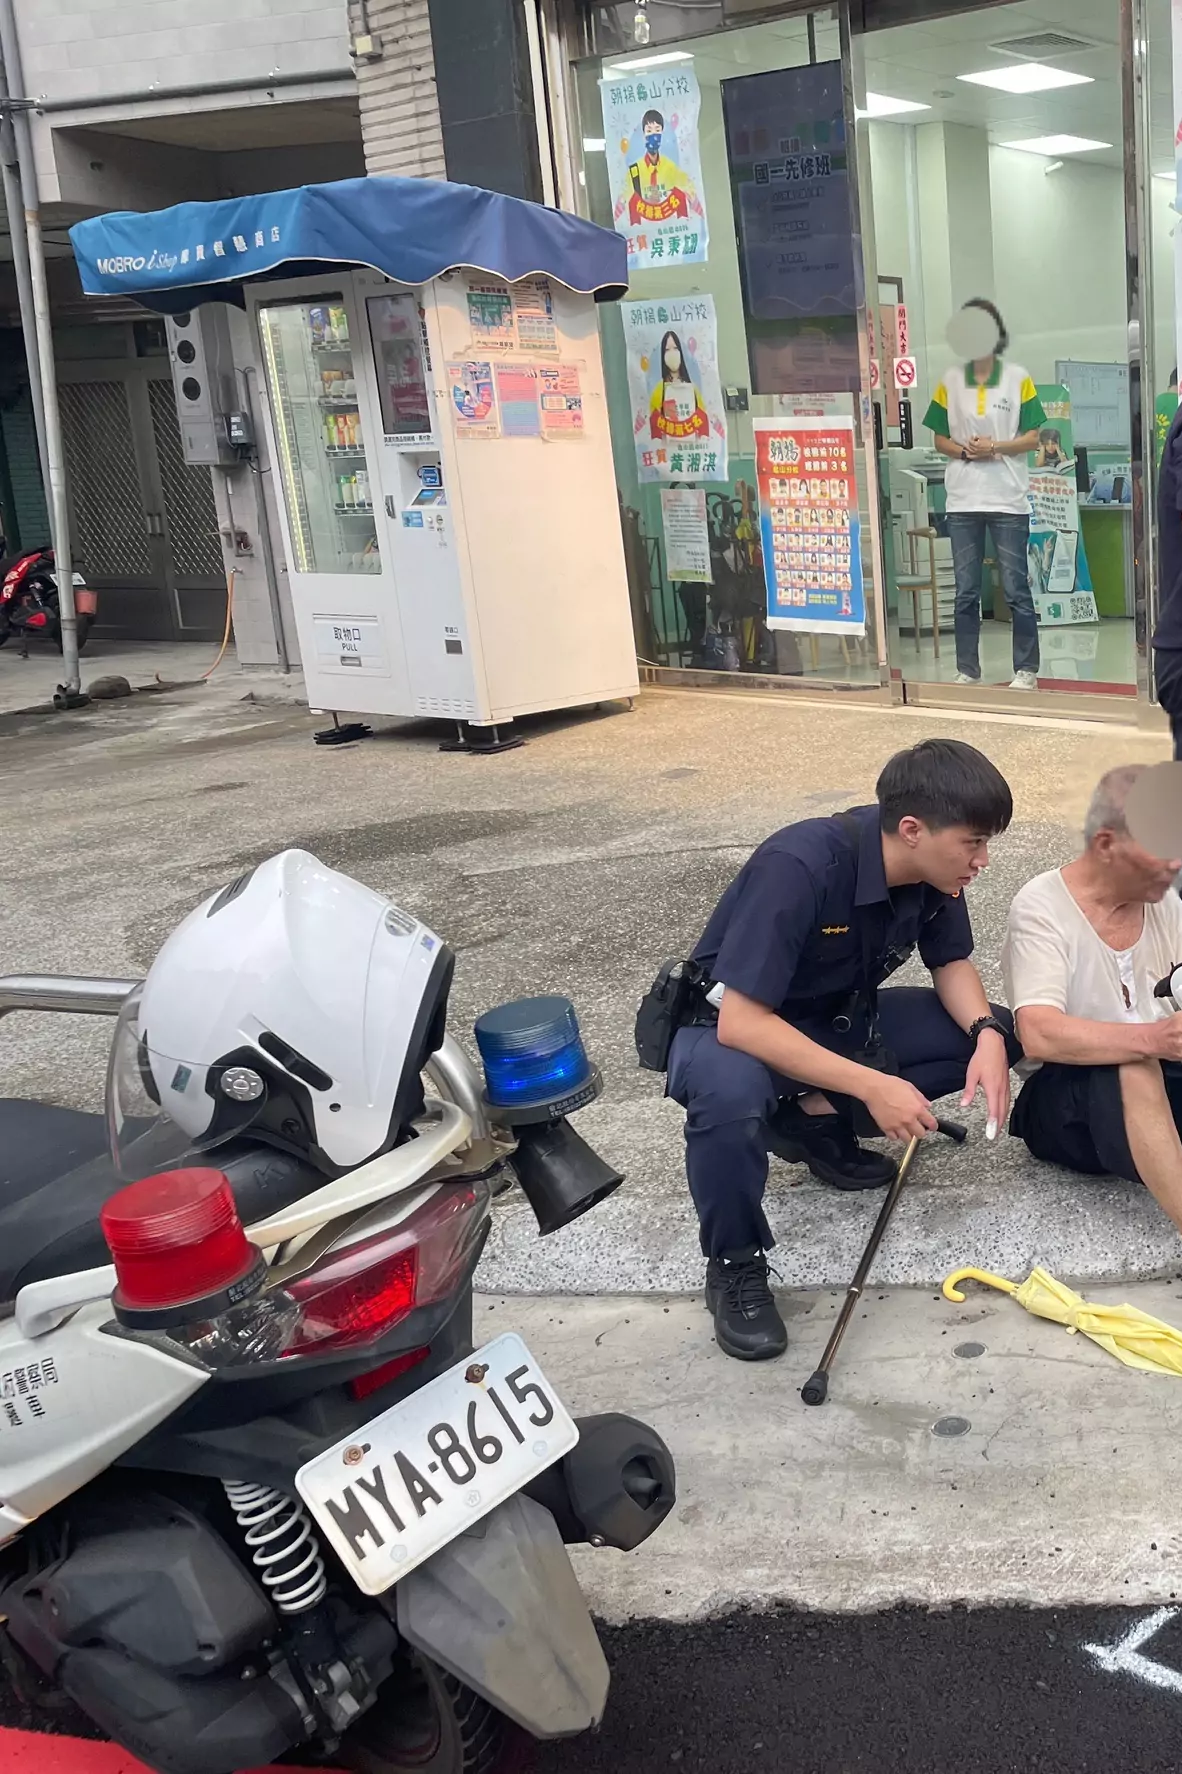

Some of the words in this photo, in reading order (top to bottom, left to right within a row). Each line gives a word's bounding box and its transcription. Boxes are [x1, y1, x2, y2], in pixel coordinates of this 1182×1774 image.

[754, 154, 832, 185] 國一先修班
[97, 256, 146, 274] MOBRO
[332, 626, 362, 642] 取物口
[341, 642, 359, 652] PULL
[324, 1364, 555, 1563] MYA-8615
